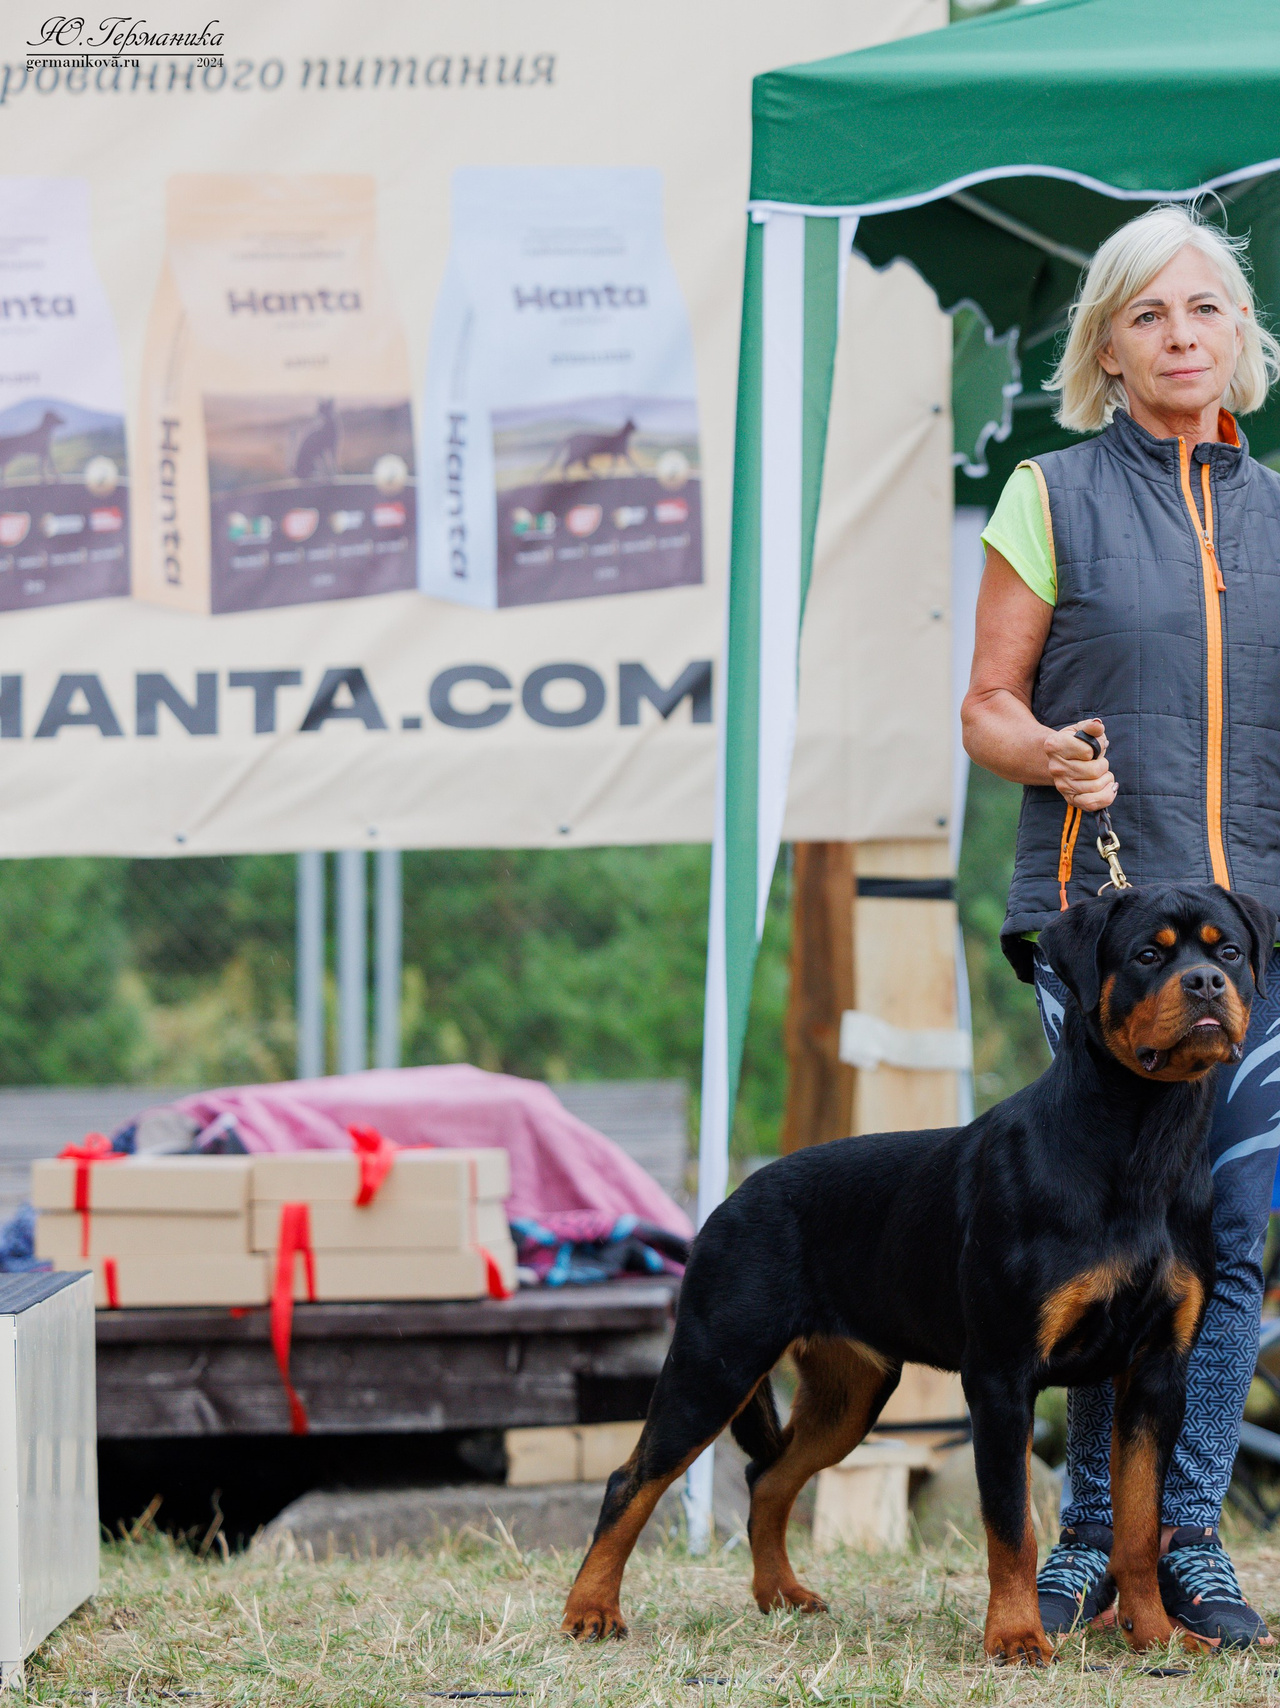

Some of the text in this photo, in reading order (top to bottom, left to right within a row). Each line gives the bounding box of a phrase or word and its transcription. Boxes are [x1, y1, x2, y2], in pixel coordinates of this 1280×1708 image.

[299, 52, 557, 89] питания
[226, 288, 362, 317] Hanta
[511, 283, 649, 314] Hanta
[159, 417, 182, 587] Hanta
[447, 411, 468, 581] Hanta
